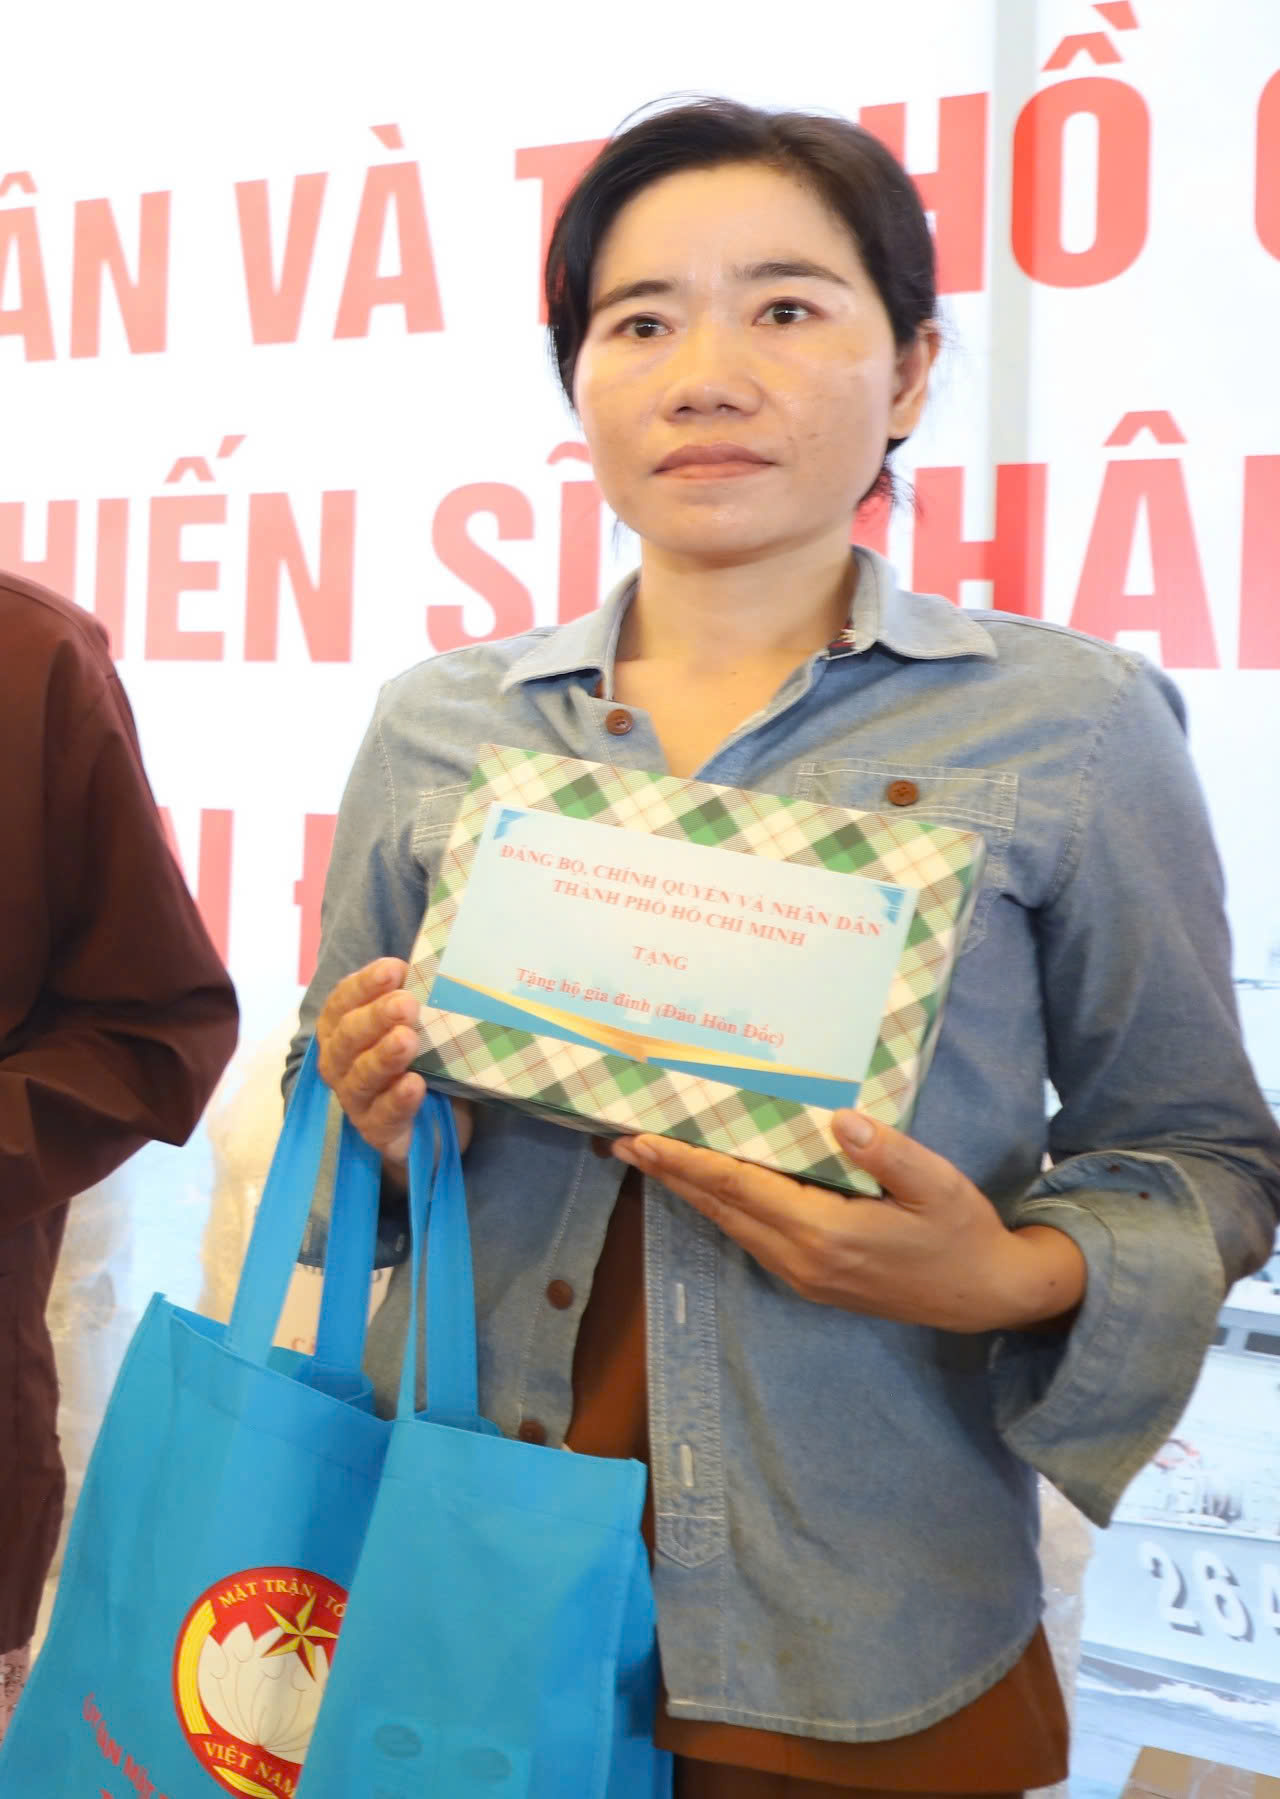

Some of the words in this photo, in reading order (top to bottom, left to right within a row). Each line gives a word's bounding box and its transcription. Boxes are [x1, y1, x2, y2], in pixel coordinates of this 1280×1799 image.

[234, 122, 446, 346] VÀ
[552, 878, 621, 905] THÀNH
[705, 912, 744, 933] CHÍ
[749, 921, 807, 947] MINH
[592, 864, 657, 889] CHÍNH
[737, 893, 764, 913] VÀ
[771, 901, 831, 927] NHÂN
[835, 914, 883, 937] DÂN
[584, 986, 609, 1003] gia
[203, 1740, 252, 1769] VIỆT
